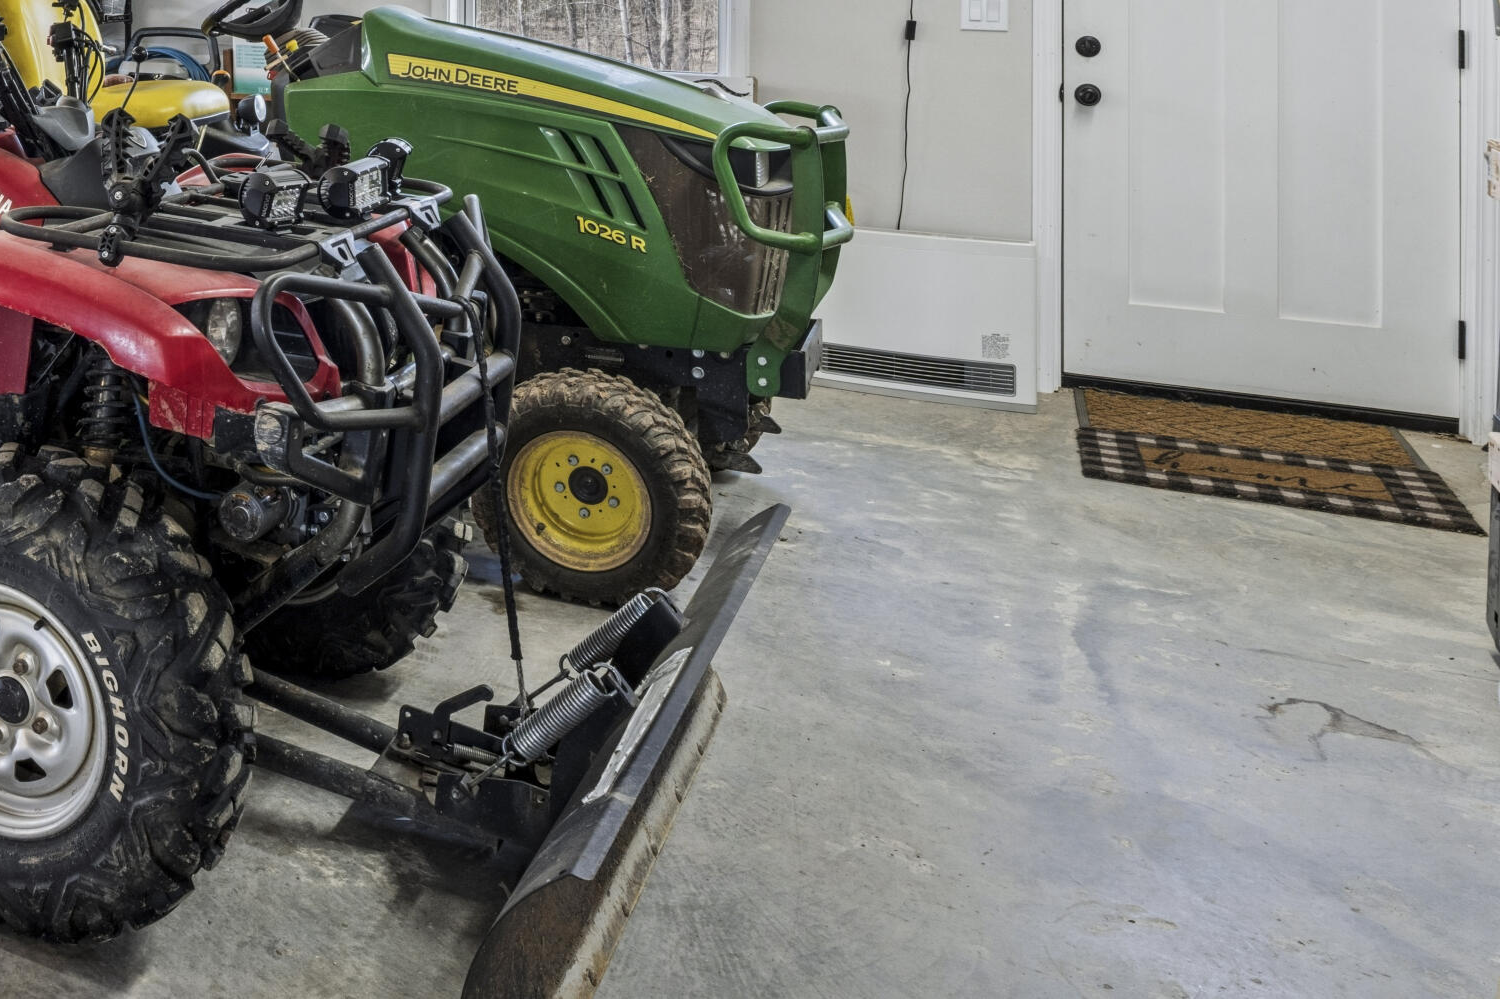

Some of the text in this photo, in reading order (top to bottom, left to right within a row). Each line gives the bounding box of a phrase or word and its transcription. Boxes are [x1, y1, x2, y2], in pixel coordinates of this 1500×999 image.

[401, 60, 519, 95] JOHN DEERE
[575, 214, 648, 254] 1026 R
[81, 631, 130, 803] BIGHORN
